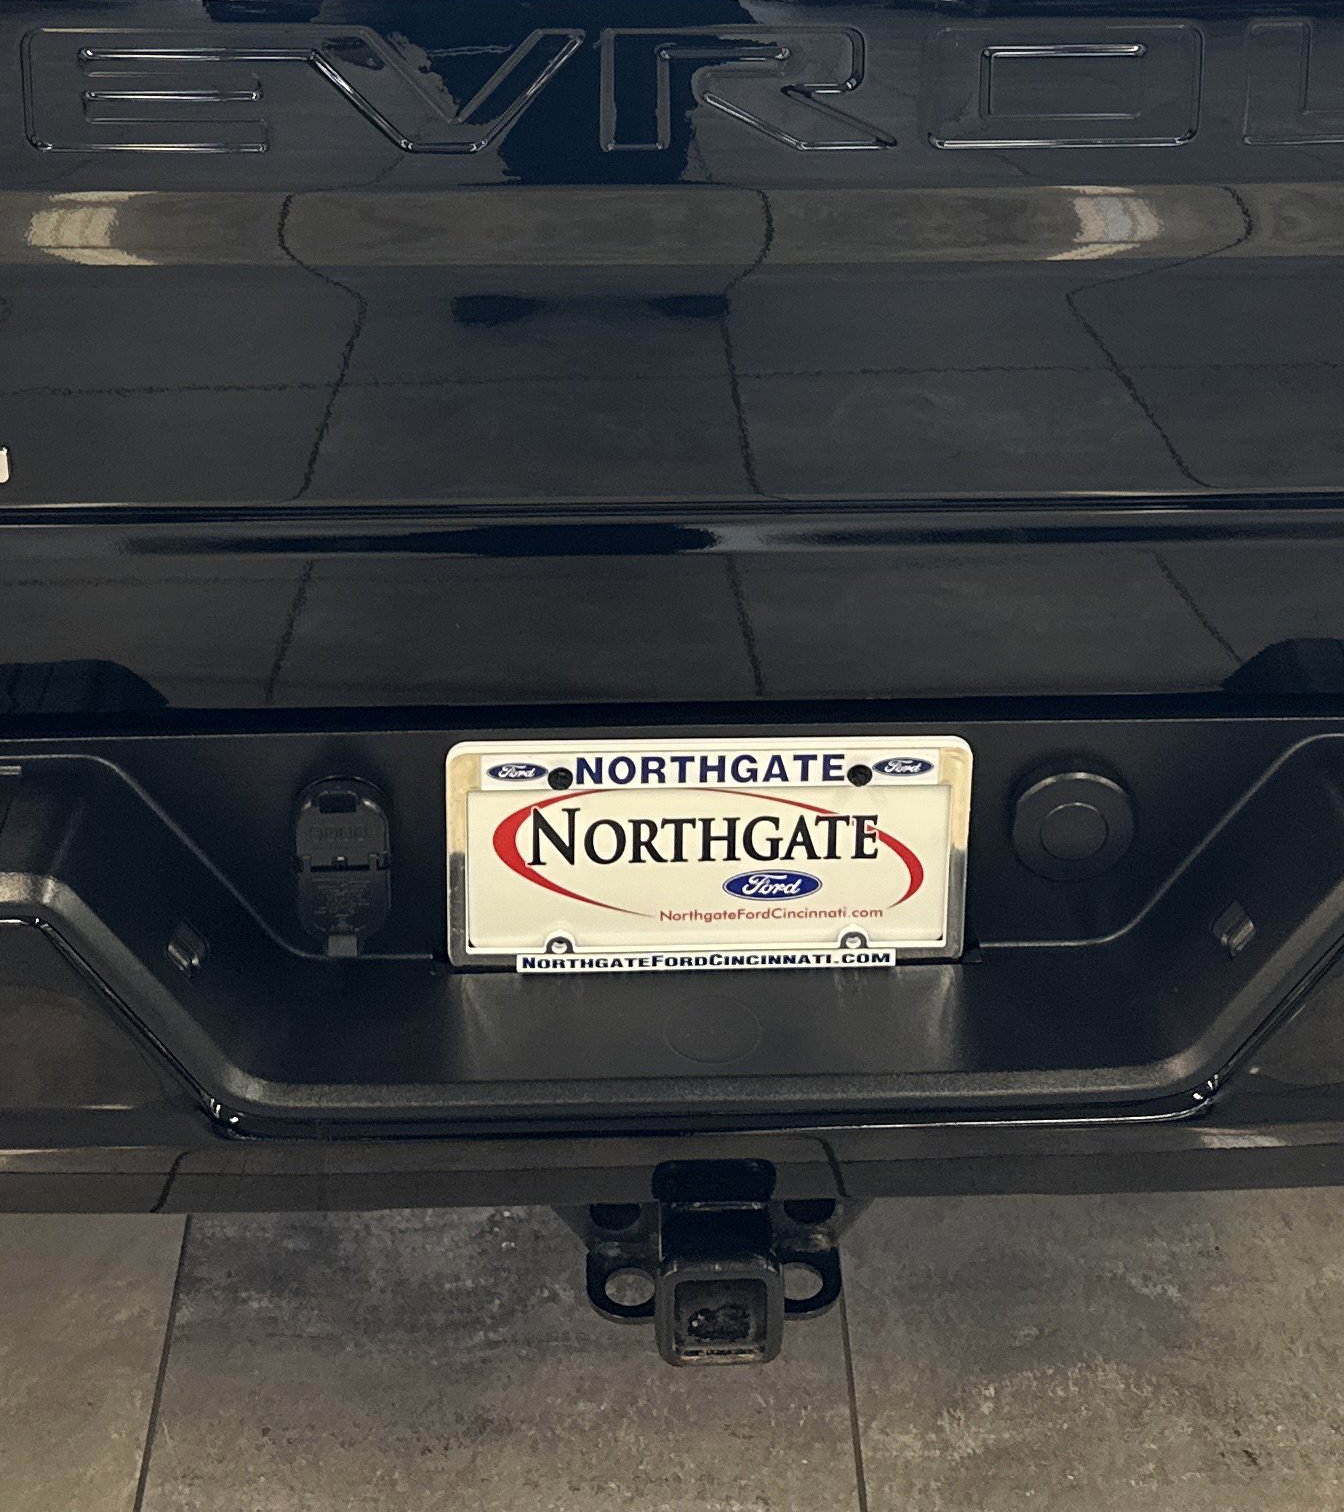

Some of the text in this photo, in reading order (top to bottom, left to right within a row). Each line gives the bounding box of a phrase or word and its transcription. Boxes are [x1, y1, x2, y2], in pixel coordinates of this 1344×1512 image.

[497, 753, 923, 785] Ford NORTHGATE Ford
[527, 807, 879, 866] NORTHGATE
[741, 874, 801, 896] Ford
[659, 906, 884, 923] NorthgateFordCincinnati.com
